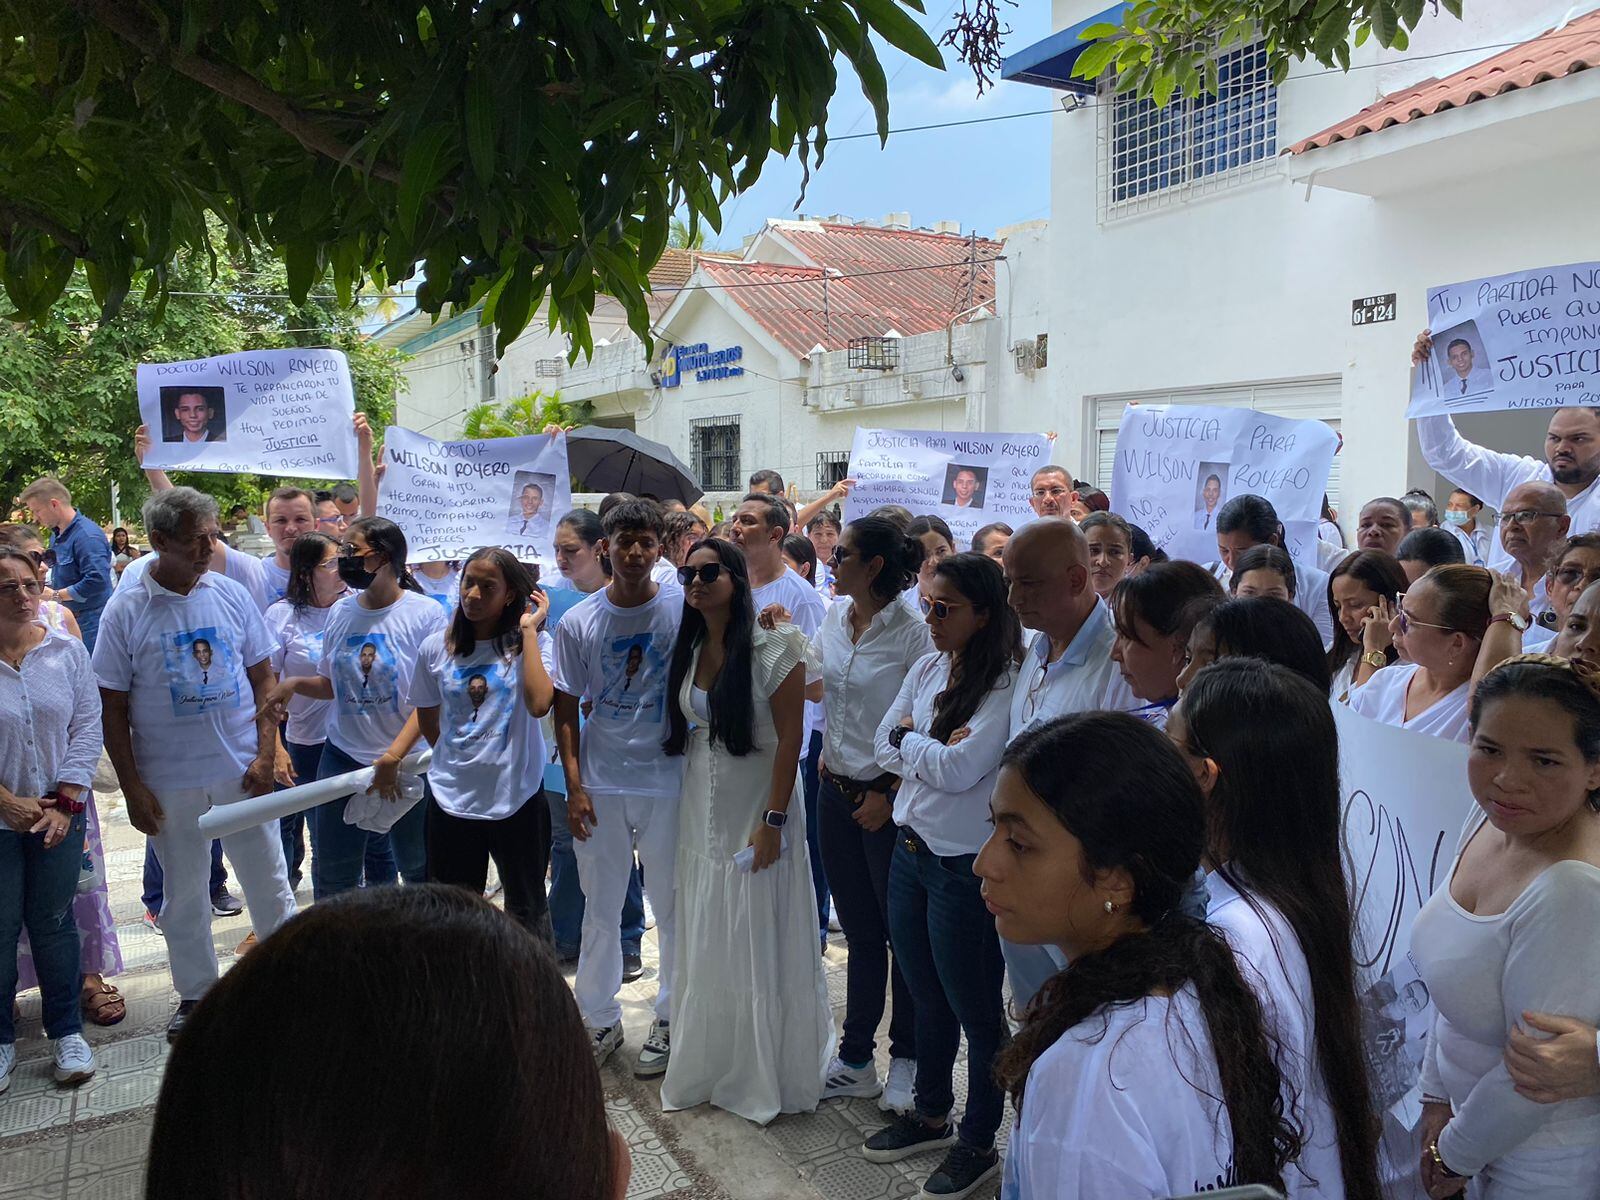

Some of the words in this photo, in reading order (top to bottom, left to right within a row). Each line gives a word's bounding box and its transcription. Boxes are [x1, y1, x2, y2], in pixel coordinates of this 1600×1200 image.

[1430, 289, 1462, 314] TU
[1477, 274, 1558, 307] PARTIDA
[1353, 303, 1394, 324] 61-124
[1497, 307, 1552, 327] PUEDE
[156, 361, 208, 376] DOCTOR
[217, 360, 275, 377] WILSON
[289, 358, 338, 374] ROYERO
[234, 383, 248, 394] TE
[254, 380, 324, 393] ARRANCARON
[327, 377, 339, 386] TU
[1555, 381, 1585, 392] PARA
[250, 394, 276, 405] VIDA
[316, 390, 329, 400] DE
[272, 414, 327, 430] PEDIMOS
[1143, 408, 1221, 442] JUSTICIA
[262, 433, 320, 452] JUSTICIA
[868, 432, 919, 449] JUSTICIA
[925, 434, 947, 448] PARA
[952, 440, 996, 456] WILSON
[1001, 442, 1040, 458] ROYERO
[1250, 424, 1297, 452] PARA
[427, 442, 489, 458] DOCTOR
[258, 461, 272, 471] TU
[280, 452, 336, 469] ASESINA
[390, 448, 448, 476] WILSON
[455, 462, 511, 479] ROYERO
[412, 474, 440, 490] GRAN
[993, 480, 1005, 489] SU
[1233, 463, 1310, 495] ROYERO
[1130, 499, 1153, 520] NO
